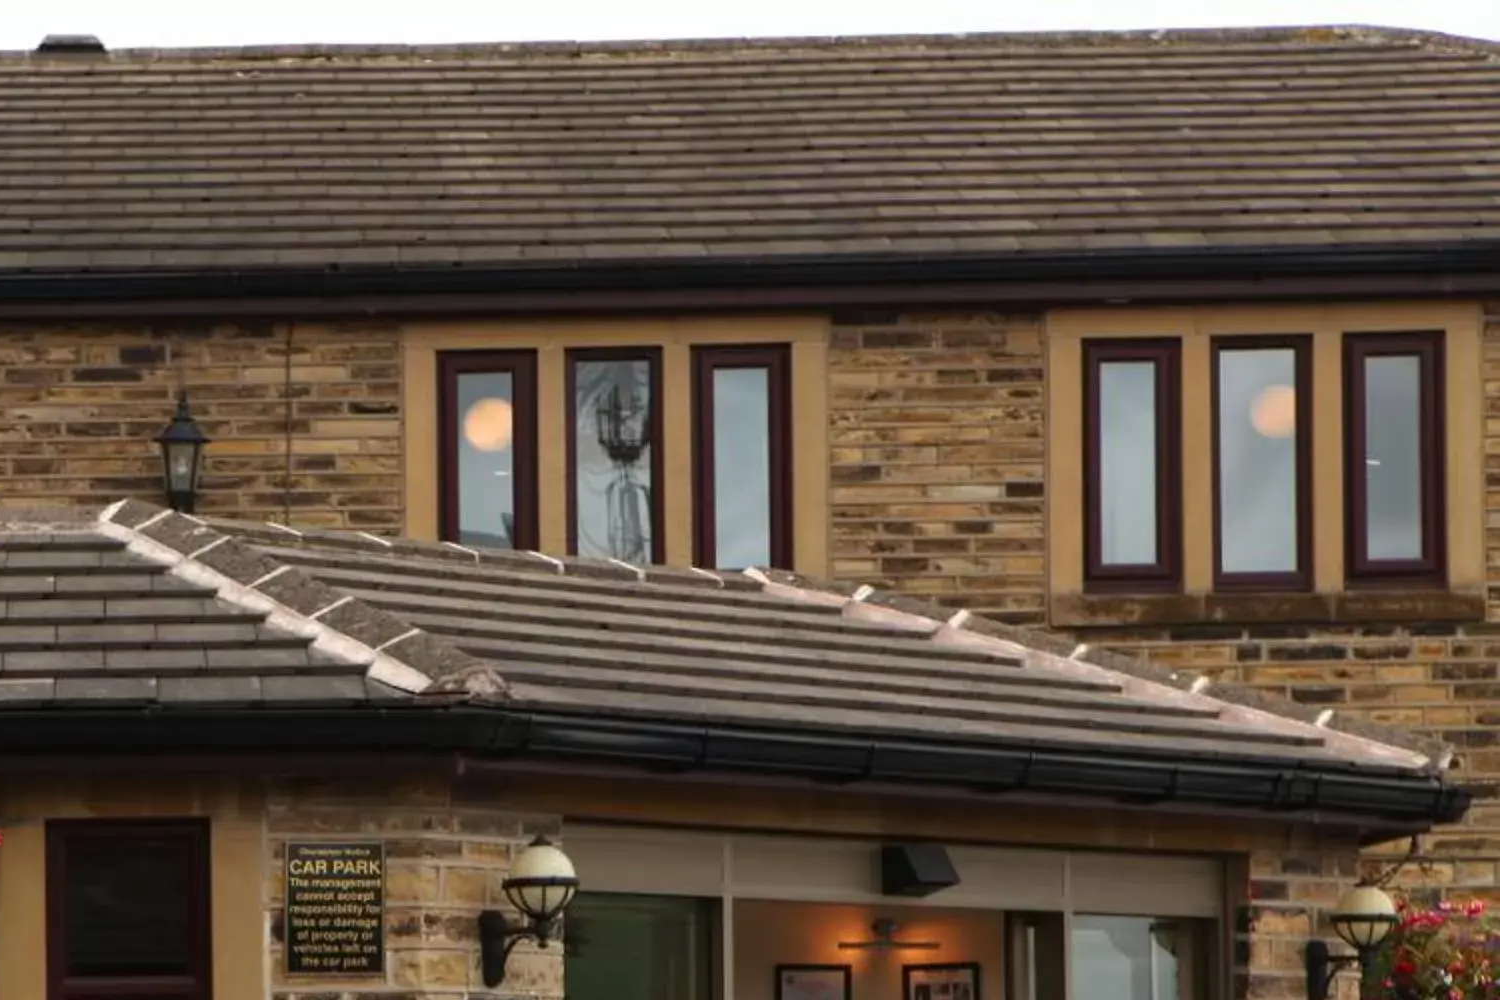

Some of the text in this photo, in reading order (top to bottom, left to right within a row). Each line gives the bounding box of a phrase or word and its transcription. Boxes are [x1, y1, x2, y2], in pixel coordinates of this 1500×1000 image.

[290, 859, 381, 875] CAR PARK
[290, 878, 381, 889] The management
[296, 892, 375, 902] cannot accept
[290, 904, 381, 916] responsibility for
[292, 917, 379, 928] loss or damage
[297, 930, 373, 942] of property or
[301, 956, 369, 968] the car park
